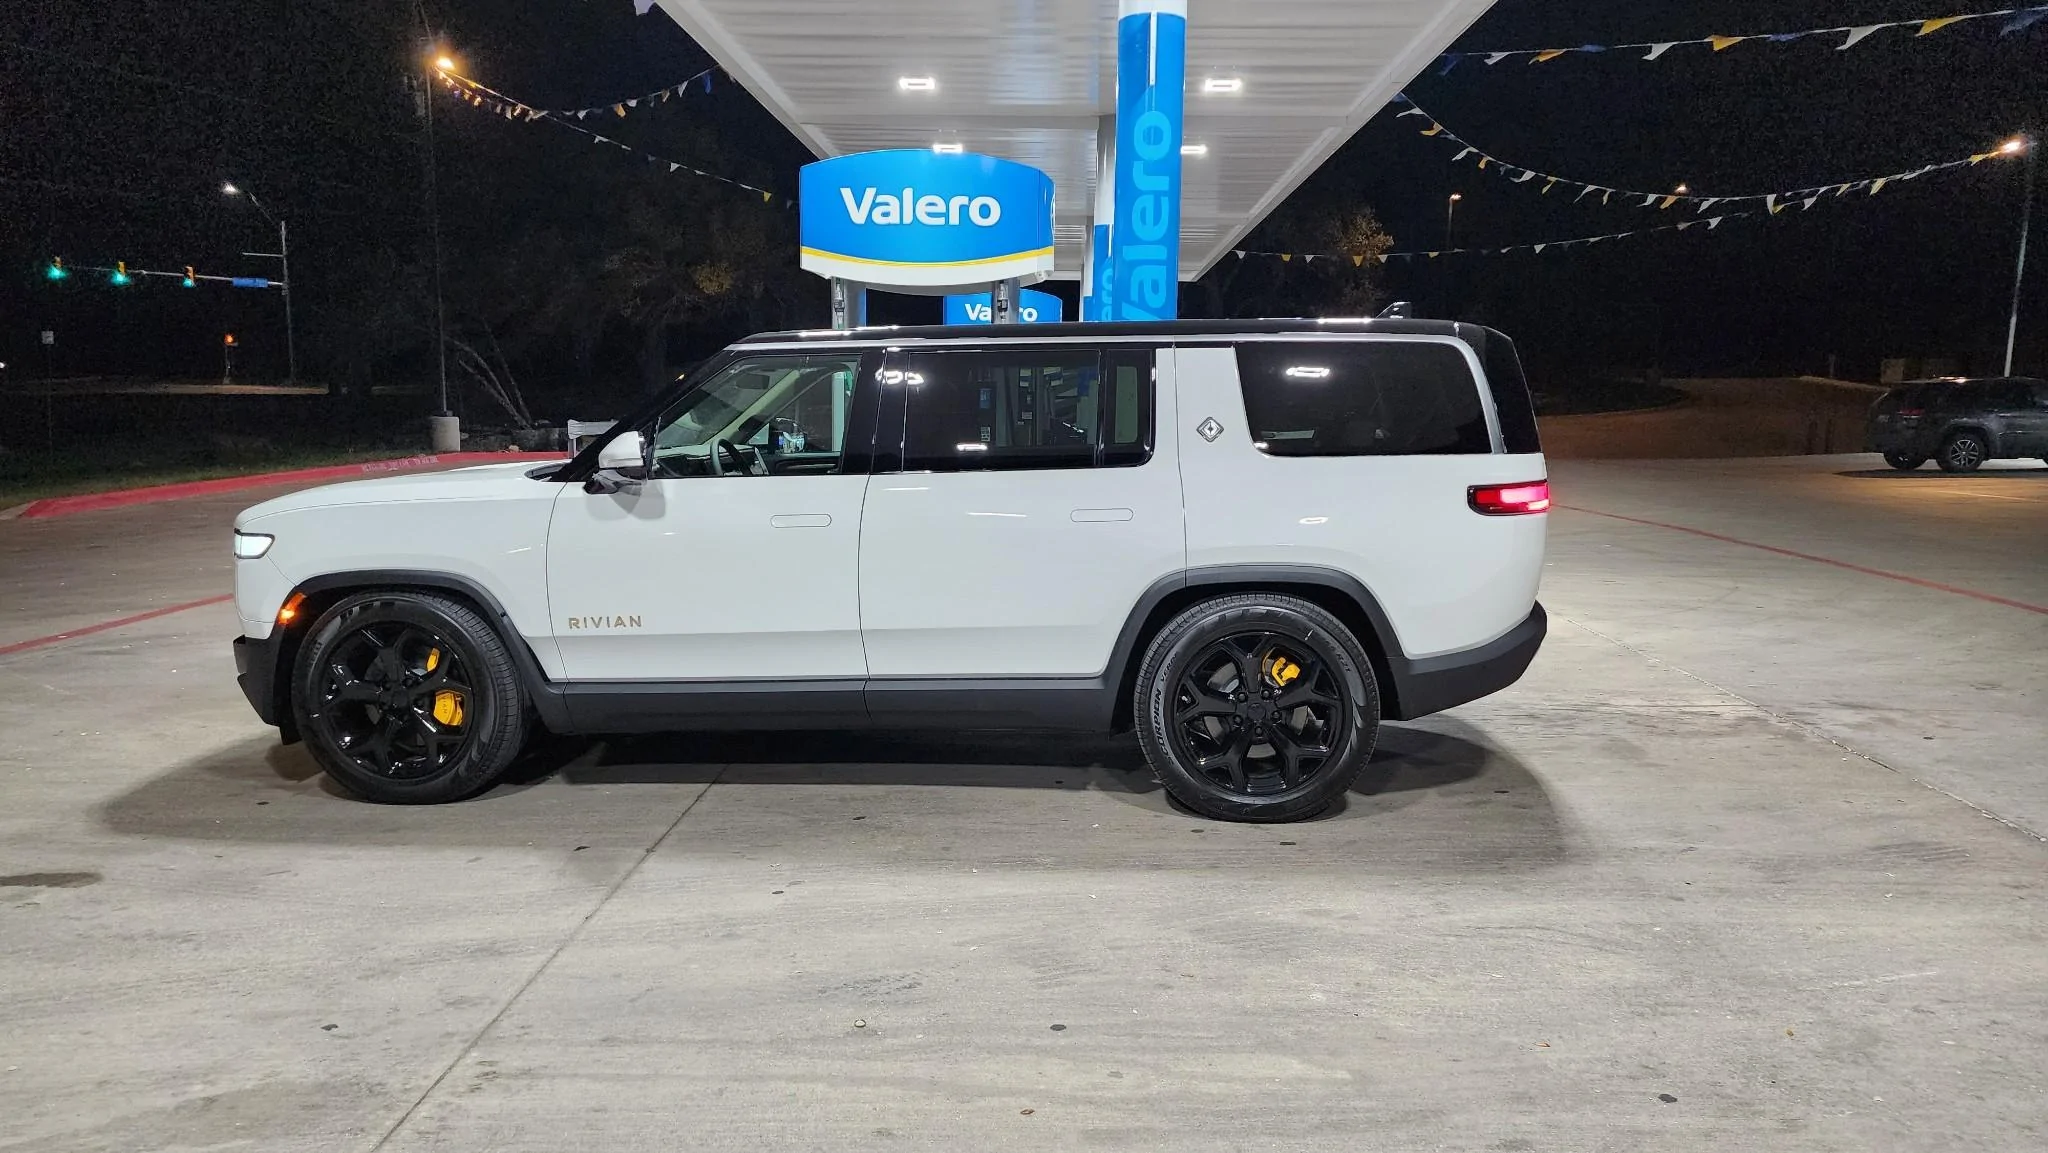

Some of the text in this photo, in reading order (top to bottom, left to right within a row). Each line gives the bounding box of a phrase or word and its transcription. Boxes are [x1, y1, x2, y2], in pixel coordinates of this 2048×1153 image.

[839, 187, 1001, 227] Valero
[964, 303, 1038, 323] Vao
[568, 615, 642, 630] RIVIAN
